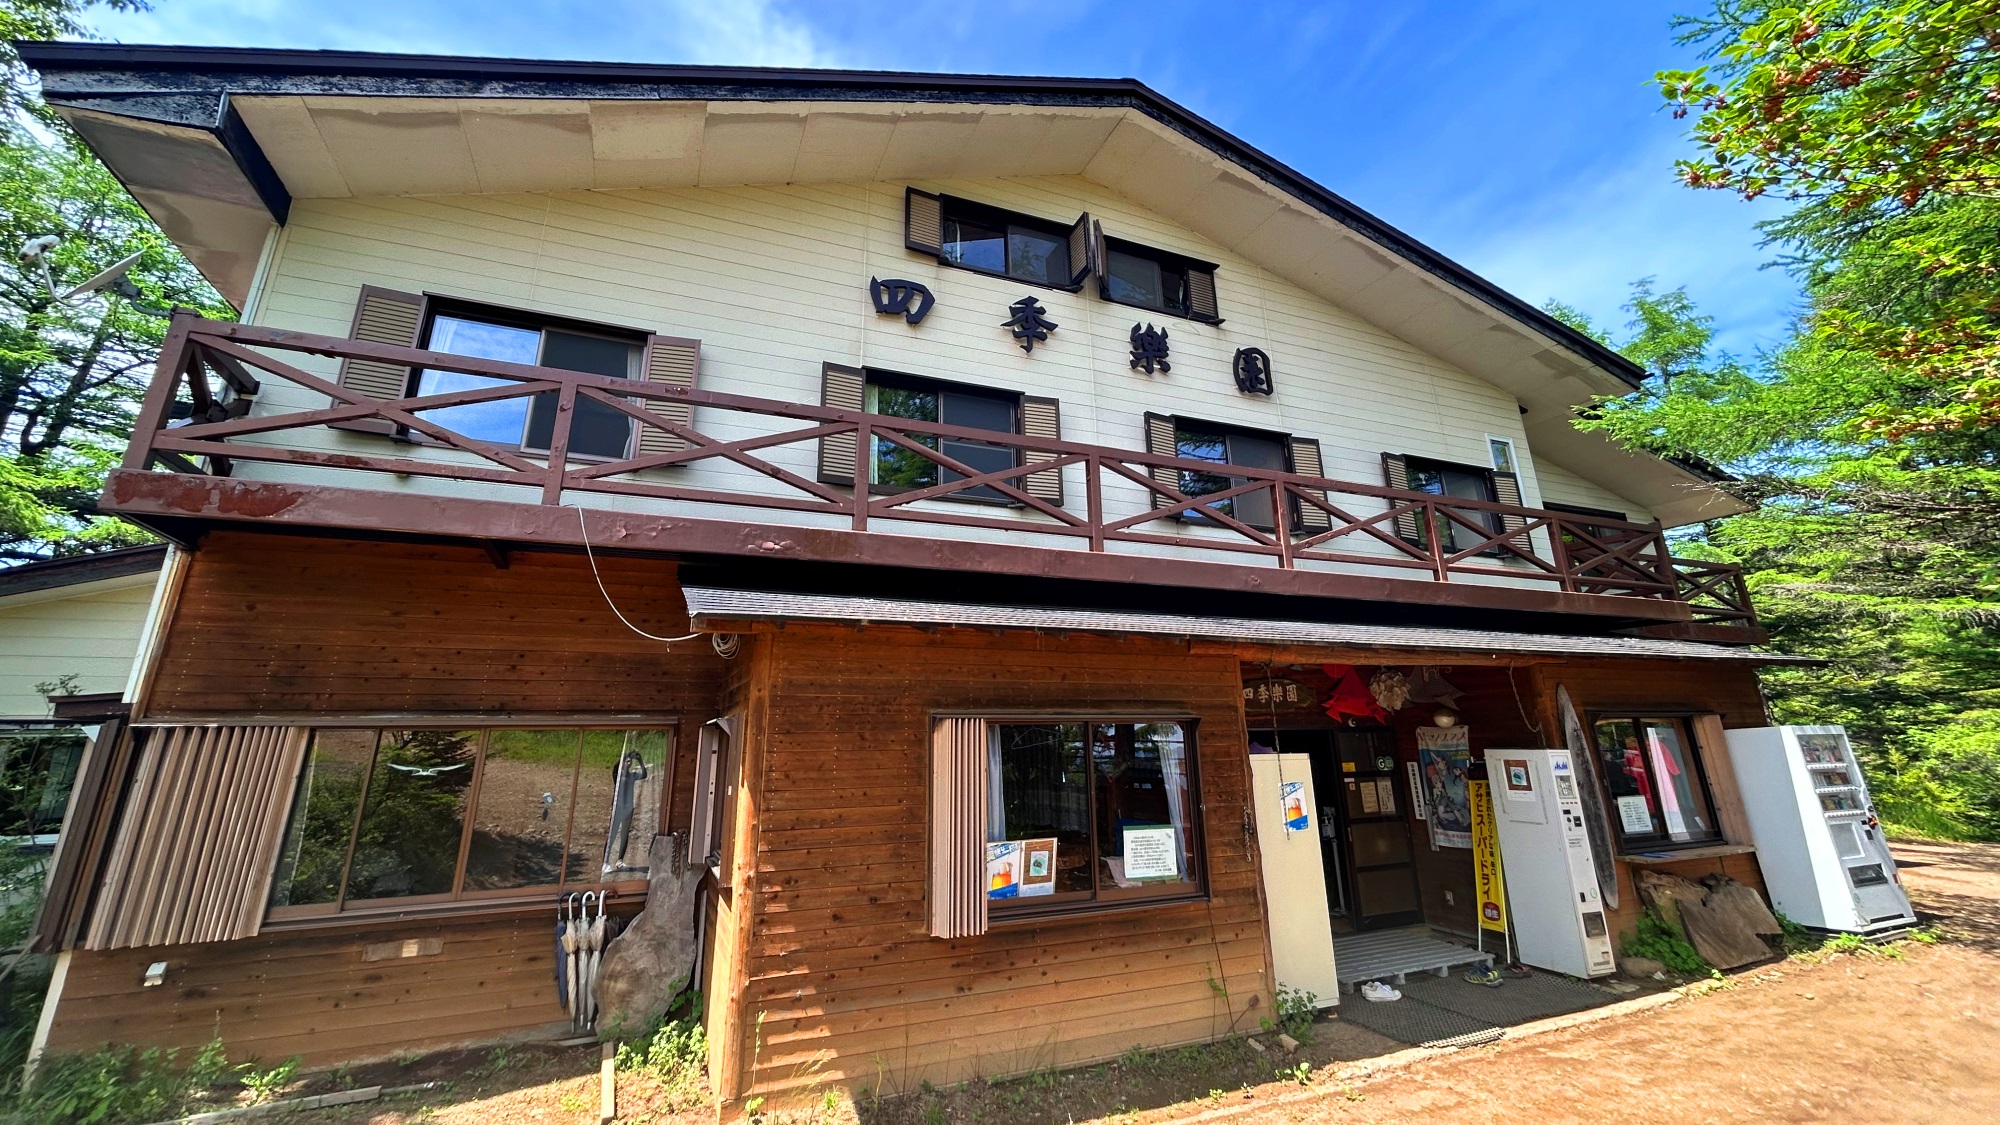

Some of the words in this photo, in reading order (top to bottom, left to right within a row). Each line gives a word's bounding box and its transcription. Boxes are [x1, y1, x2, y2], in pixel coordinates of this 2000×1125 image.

[1474, 783, 1490, 900] アサヒスーパードライ
